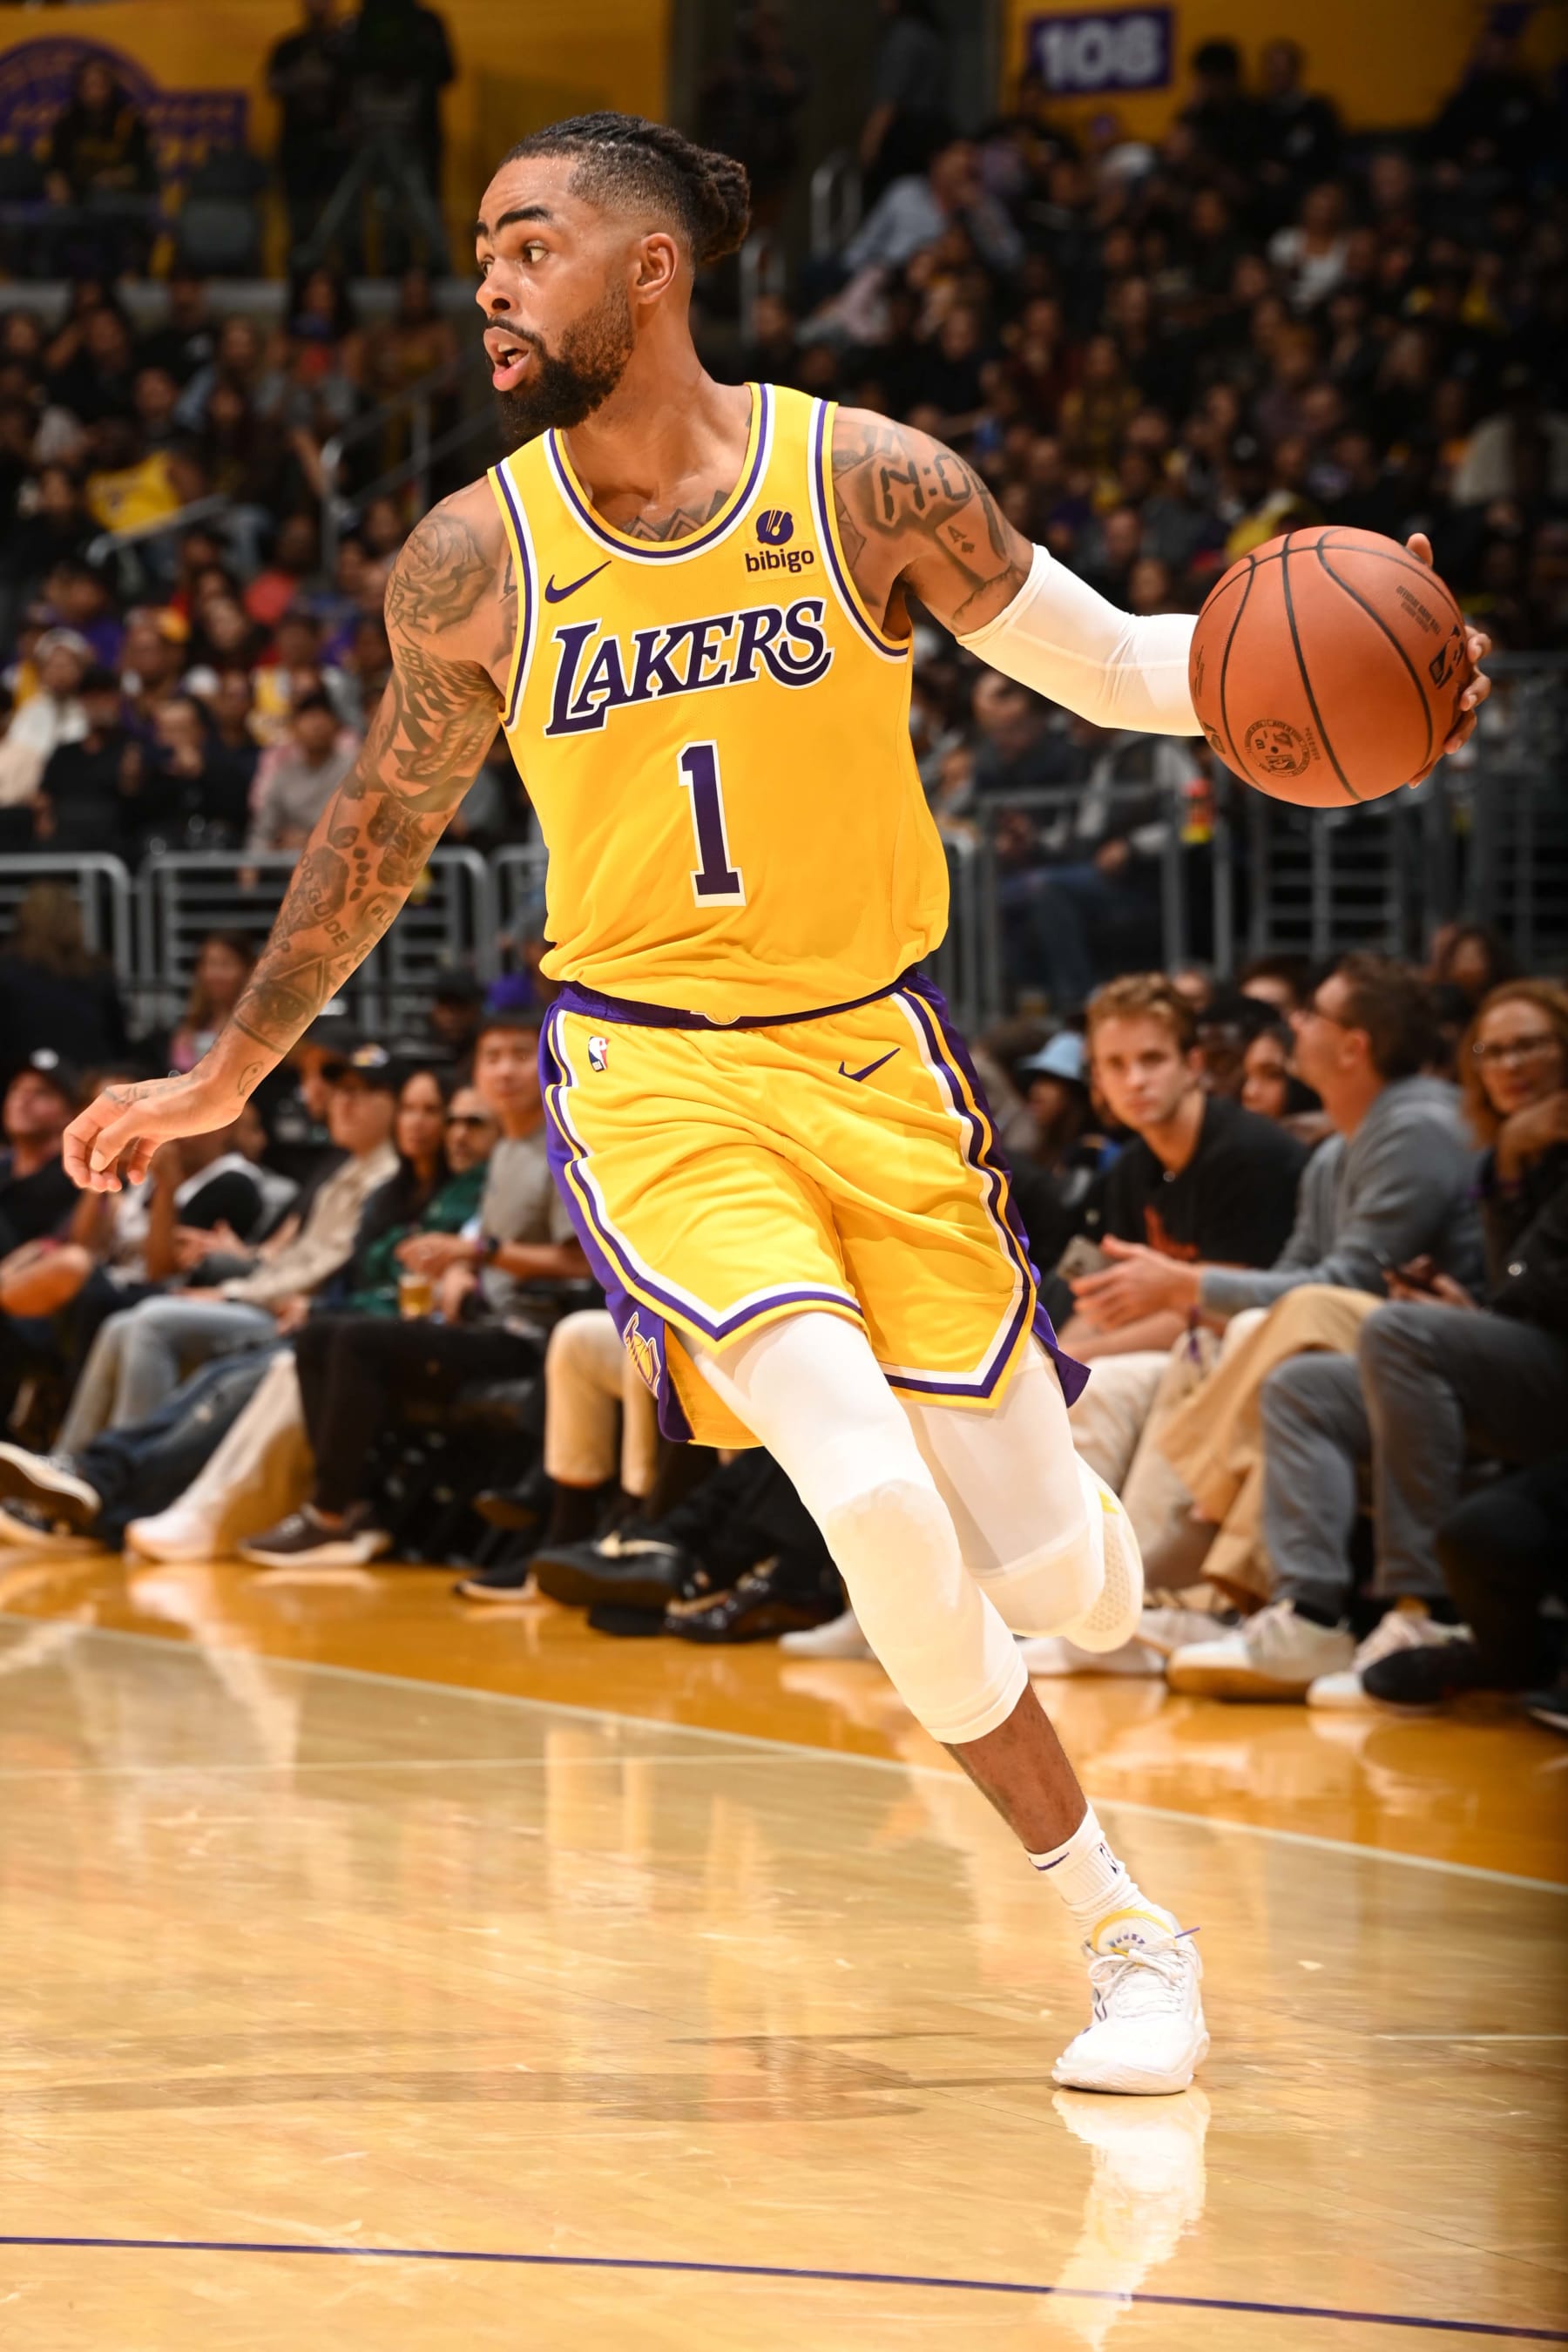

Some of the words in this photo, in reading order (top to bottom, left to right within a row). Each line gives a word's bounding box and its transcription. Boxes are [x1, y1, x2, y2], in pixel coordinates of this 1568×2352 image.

[1038, 17, 1161, 91] 108
[745, 548, 814, 573] bibigo
[947, 524, 966, 544] A
[544, 596, 835, 739] LAKERS
[676, 740, 747, 908] 1
